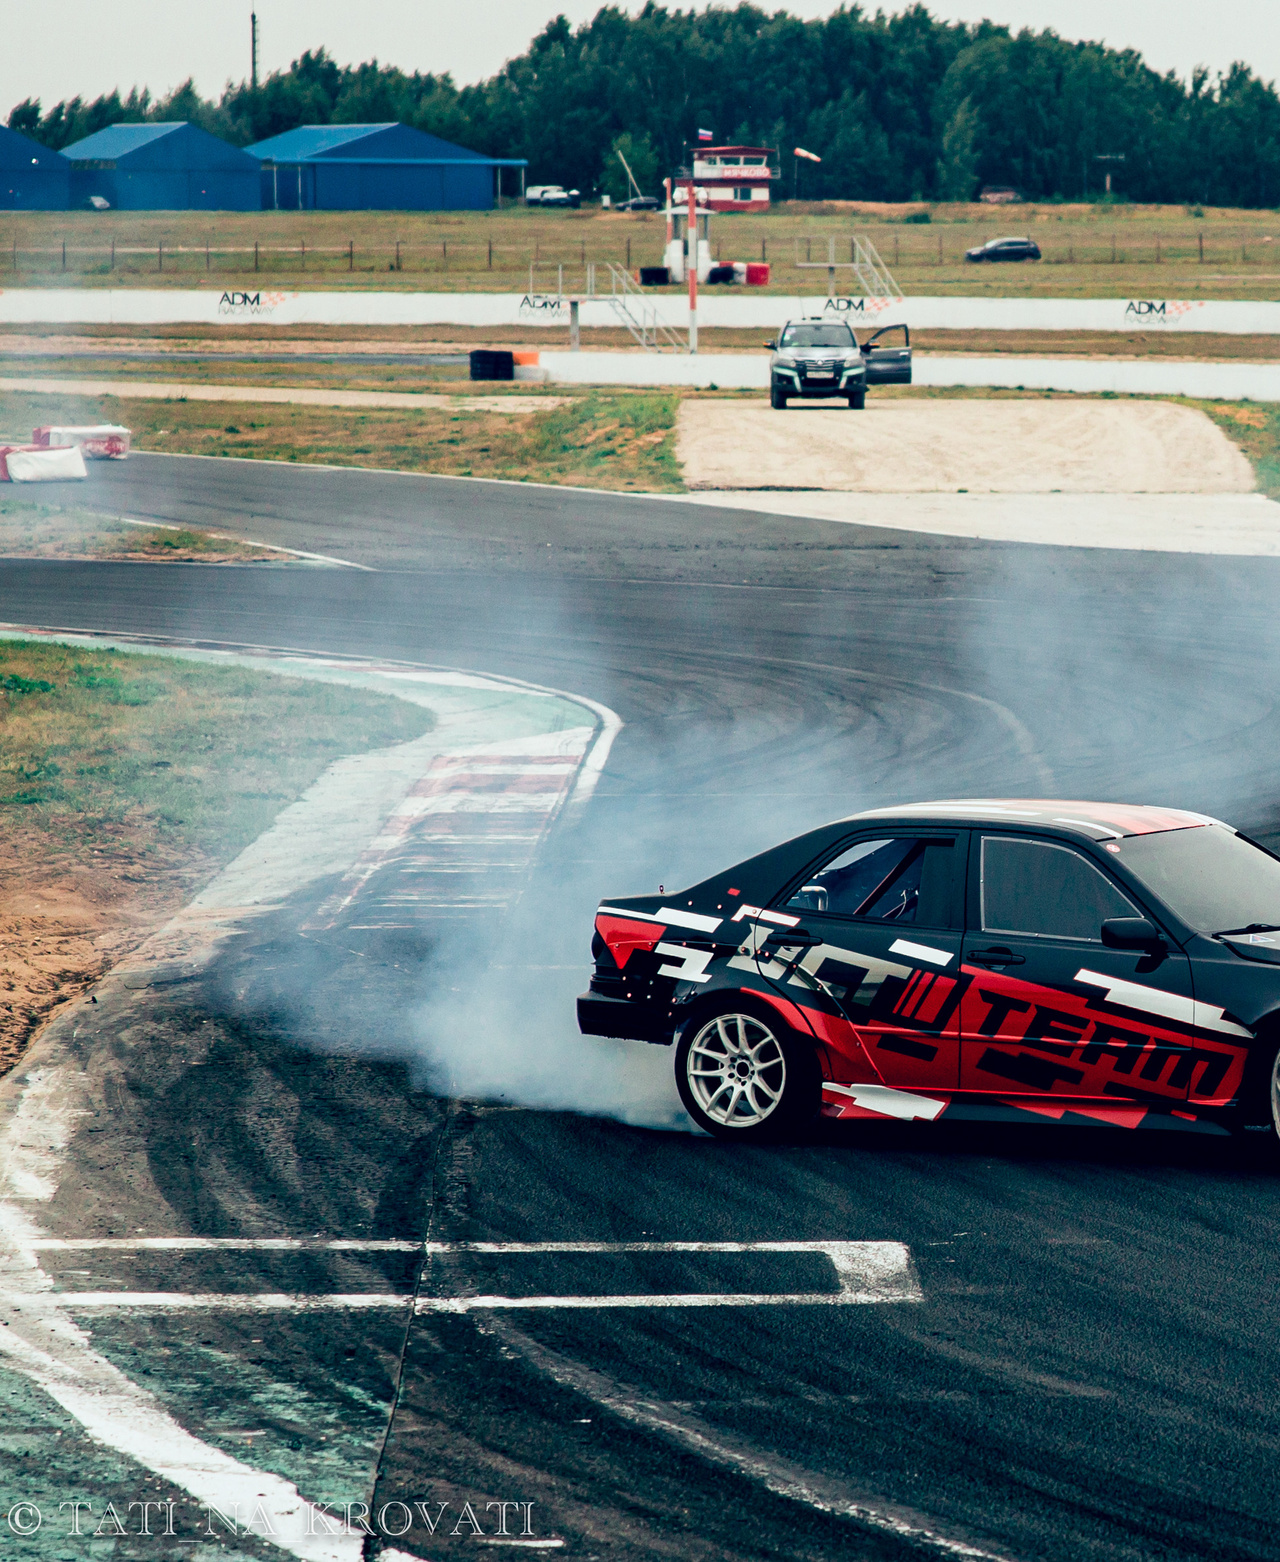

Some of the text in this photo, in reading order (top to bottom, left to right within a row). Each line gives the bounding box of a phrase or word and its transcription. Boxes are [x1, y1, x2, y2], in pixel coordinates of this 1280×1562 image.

[220, 291, 260, 306] ADM
[824, 298, 865, 311] ADM
[1125, 301, 1166, 315] ADM
[978, 988, 1235, 1097] TEAM
